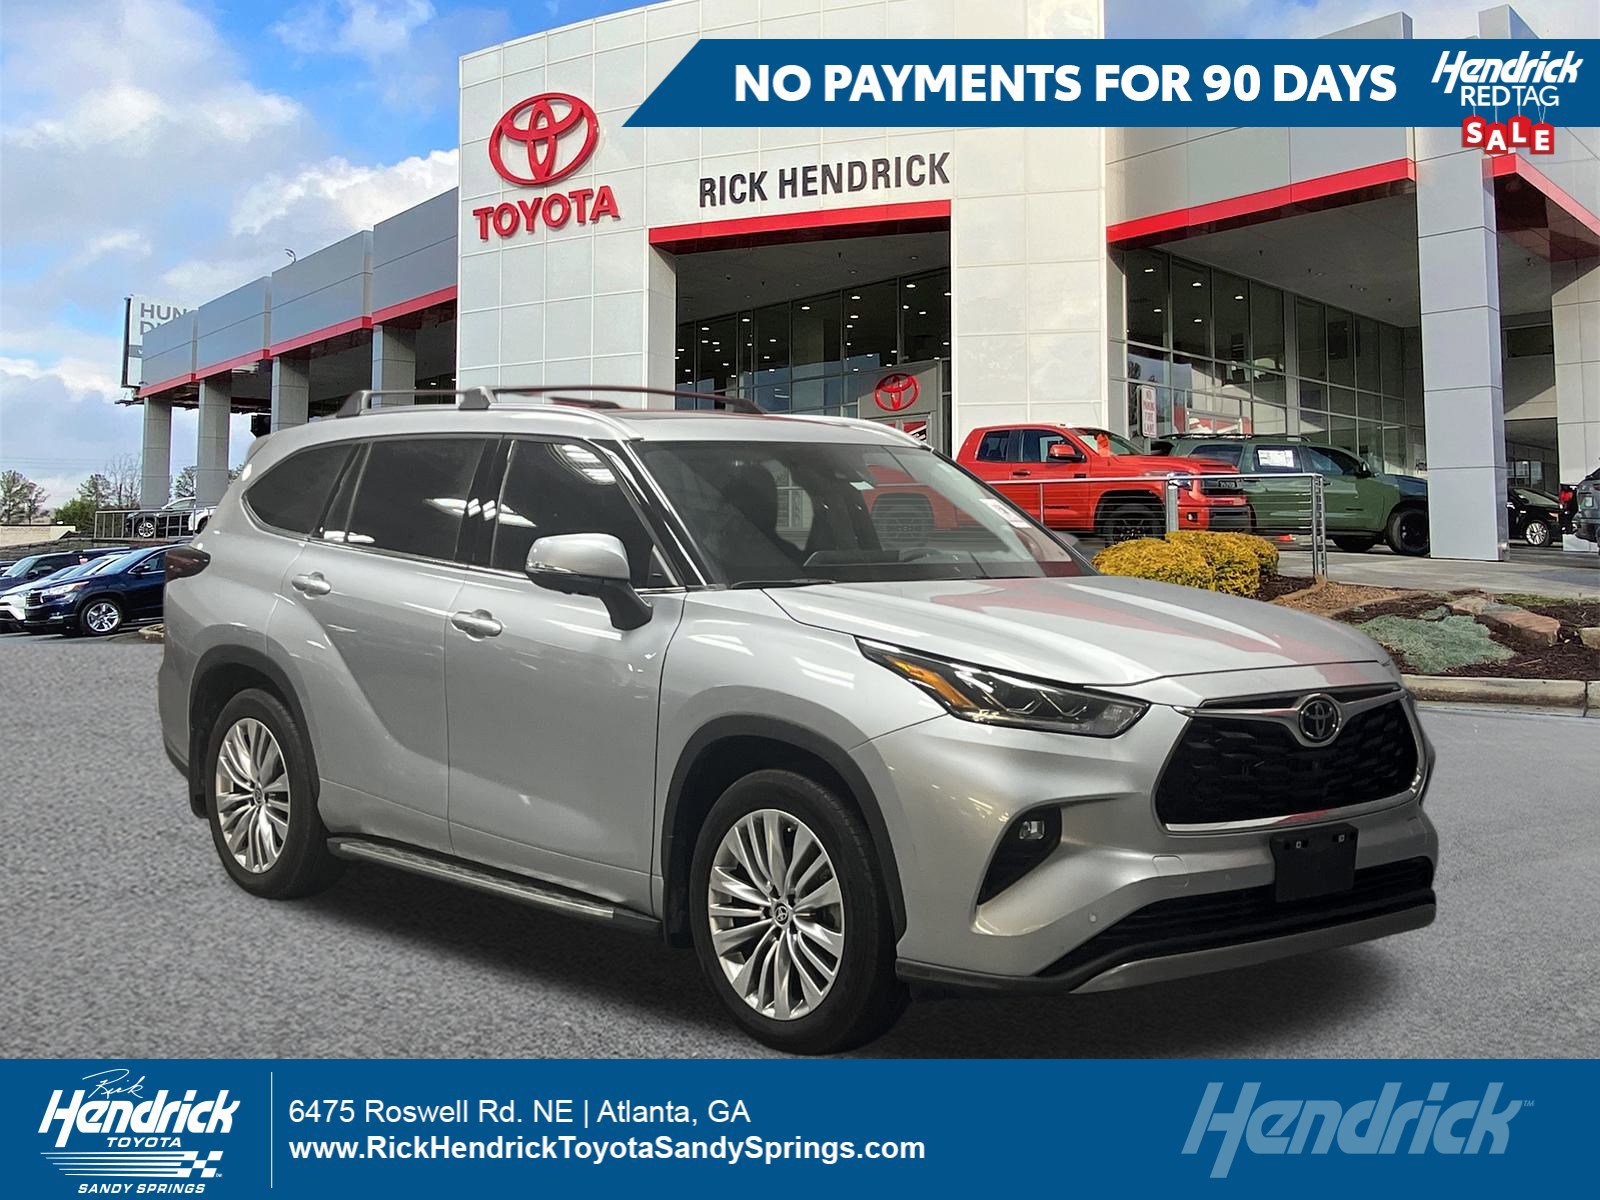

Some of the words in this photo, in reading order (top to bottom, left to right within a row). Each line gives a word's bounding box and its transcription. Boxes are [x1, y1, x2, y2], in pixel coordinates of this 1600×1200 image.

[699, 170, 769, 208] RICK
[778, 151, 951, 199] HENDRICK
[472, 184, 620, 241] TOYOTA
